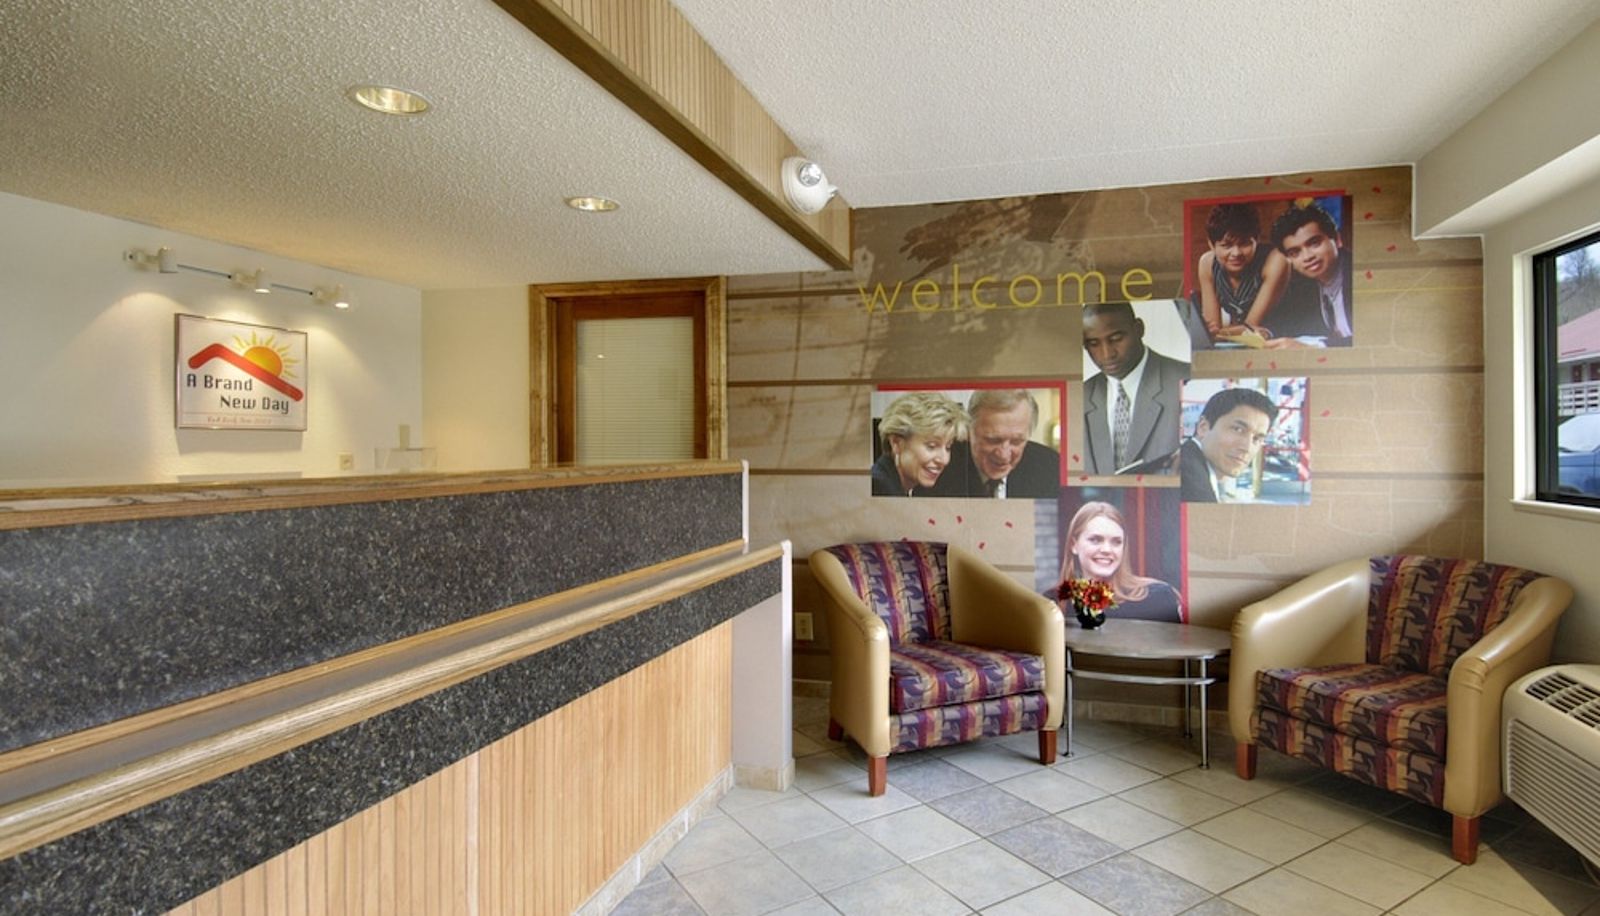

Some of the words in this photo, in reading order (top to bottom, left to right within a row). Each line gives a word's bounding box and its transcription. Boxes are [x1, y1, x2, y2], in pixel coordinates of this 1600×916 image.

[858, 264, 1152, 312] welcome
[187, 374, 197, 387] A
[204, 375, 253, 391] Brand
[220, 395, 257, 409] New
[261, 397, 289, 414] Day
